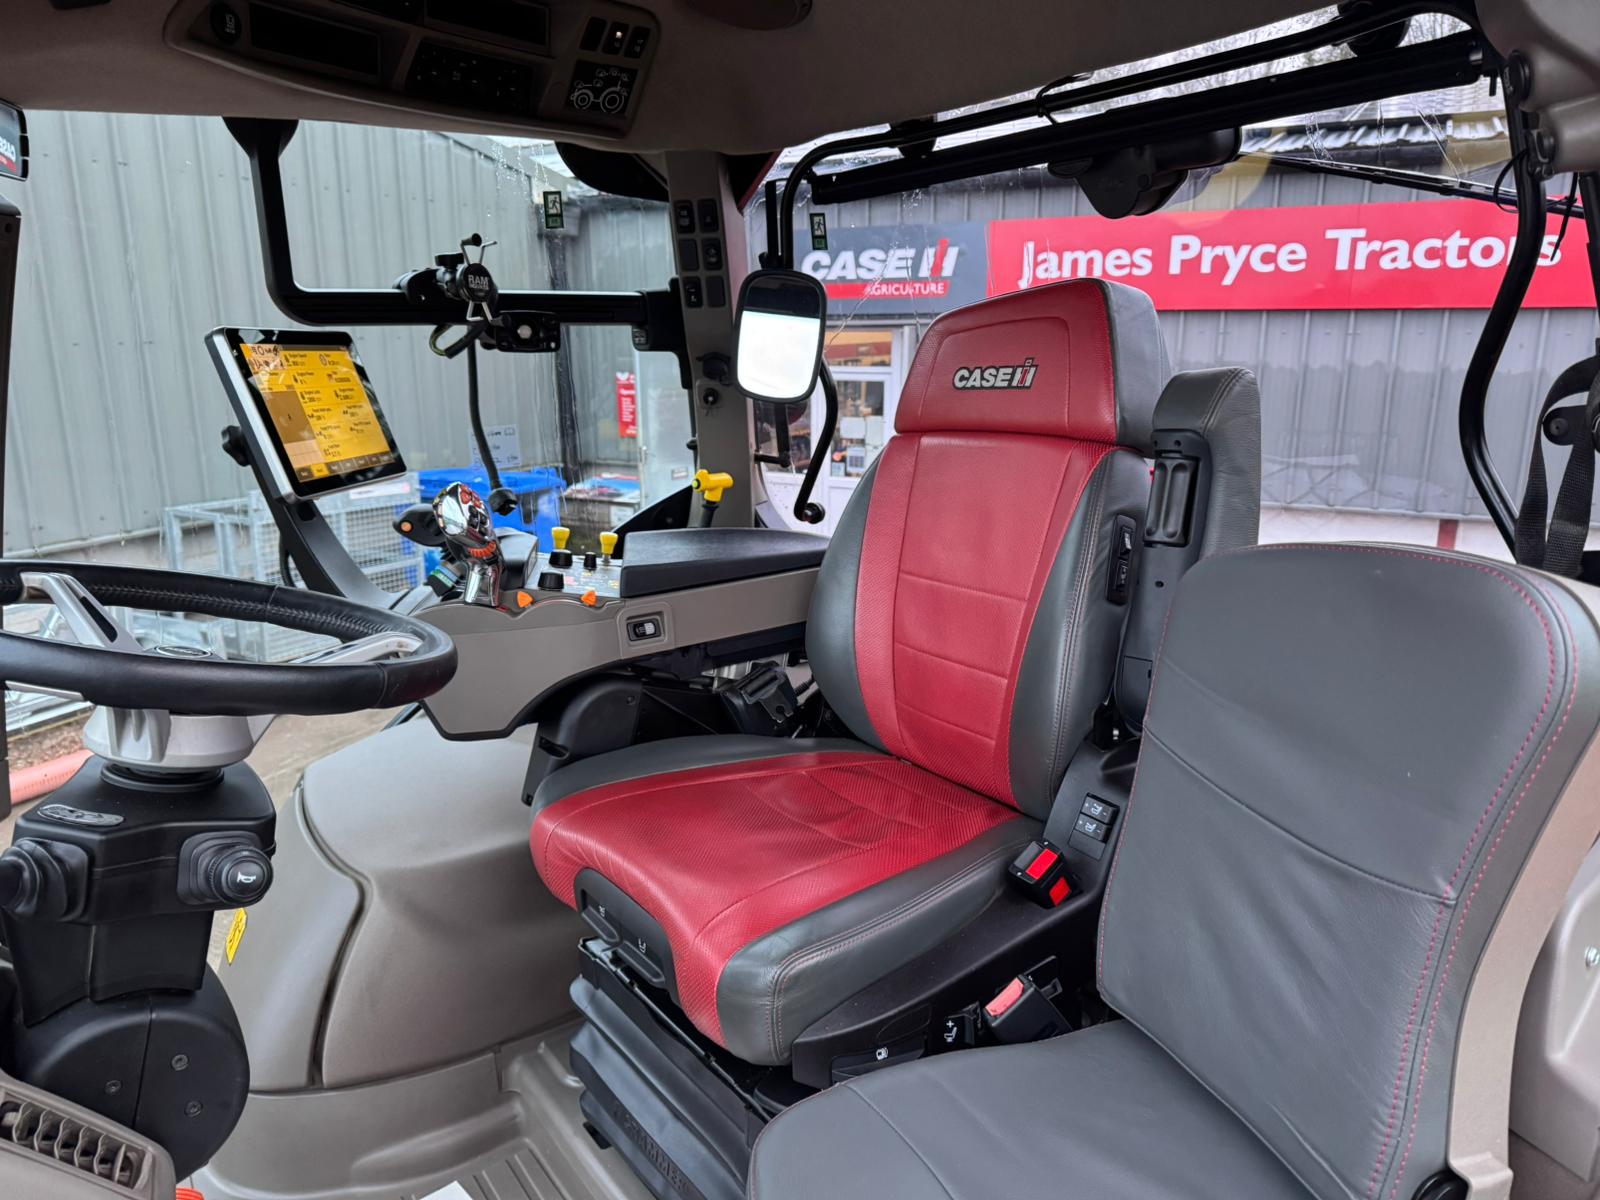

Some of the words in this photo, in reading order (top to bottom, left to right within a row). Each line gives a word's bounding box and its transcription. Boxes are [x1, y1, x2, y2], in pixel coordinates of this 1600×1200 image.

[801, 248, 916, 281] CASE
[1018, 240, 1153, 289] James
[1168, 234, 1308, 286] Pryce
[468, 274, 488, 285] RAM
[867, 282, 945, 296] AGRICULTURE
[953, 366, 1012, 389] CASE
